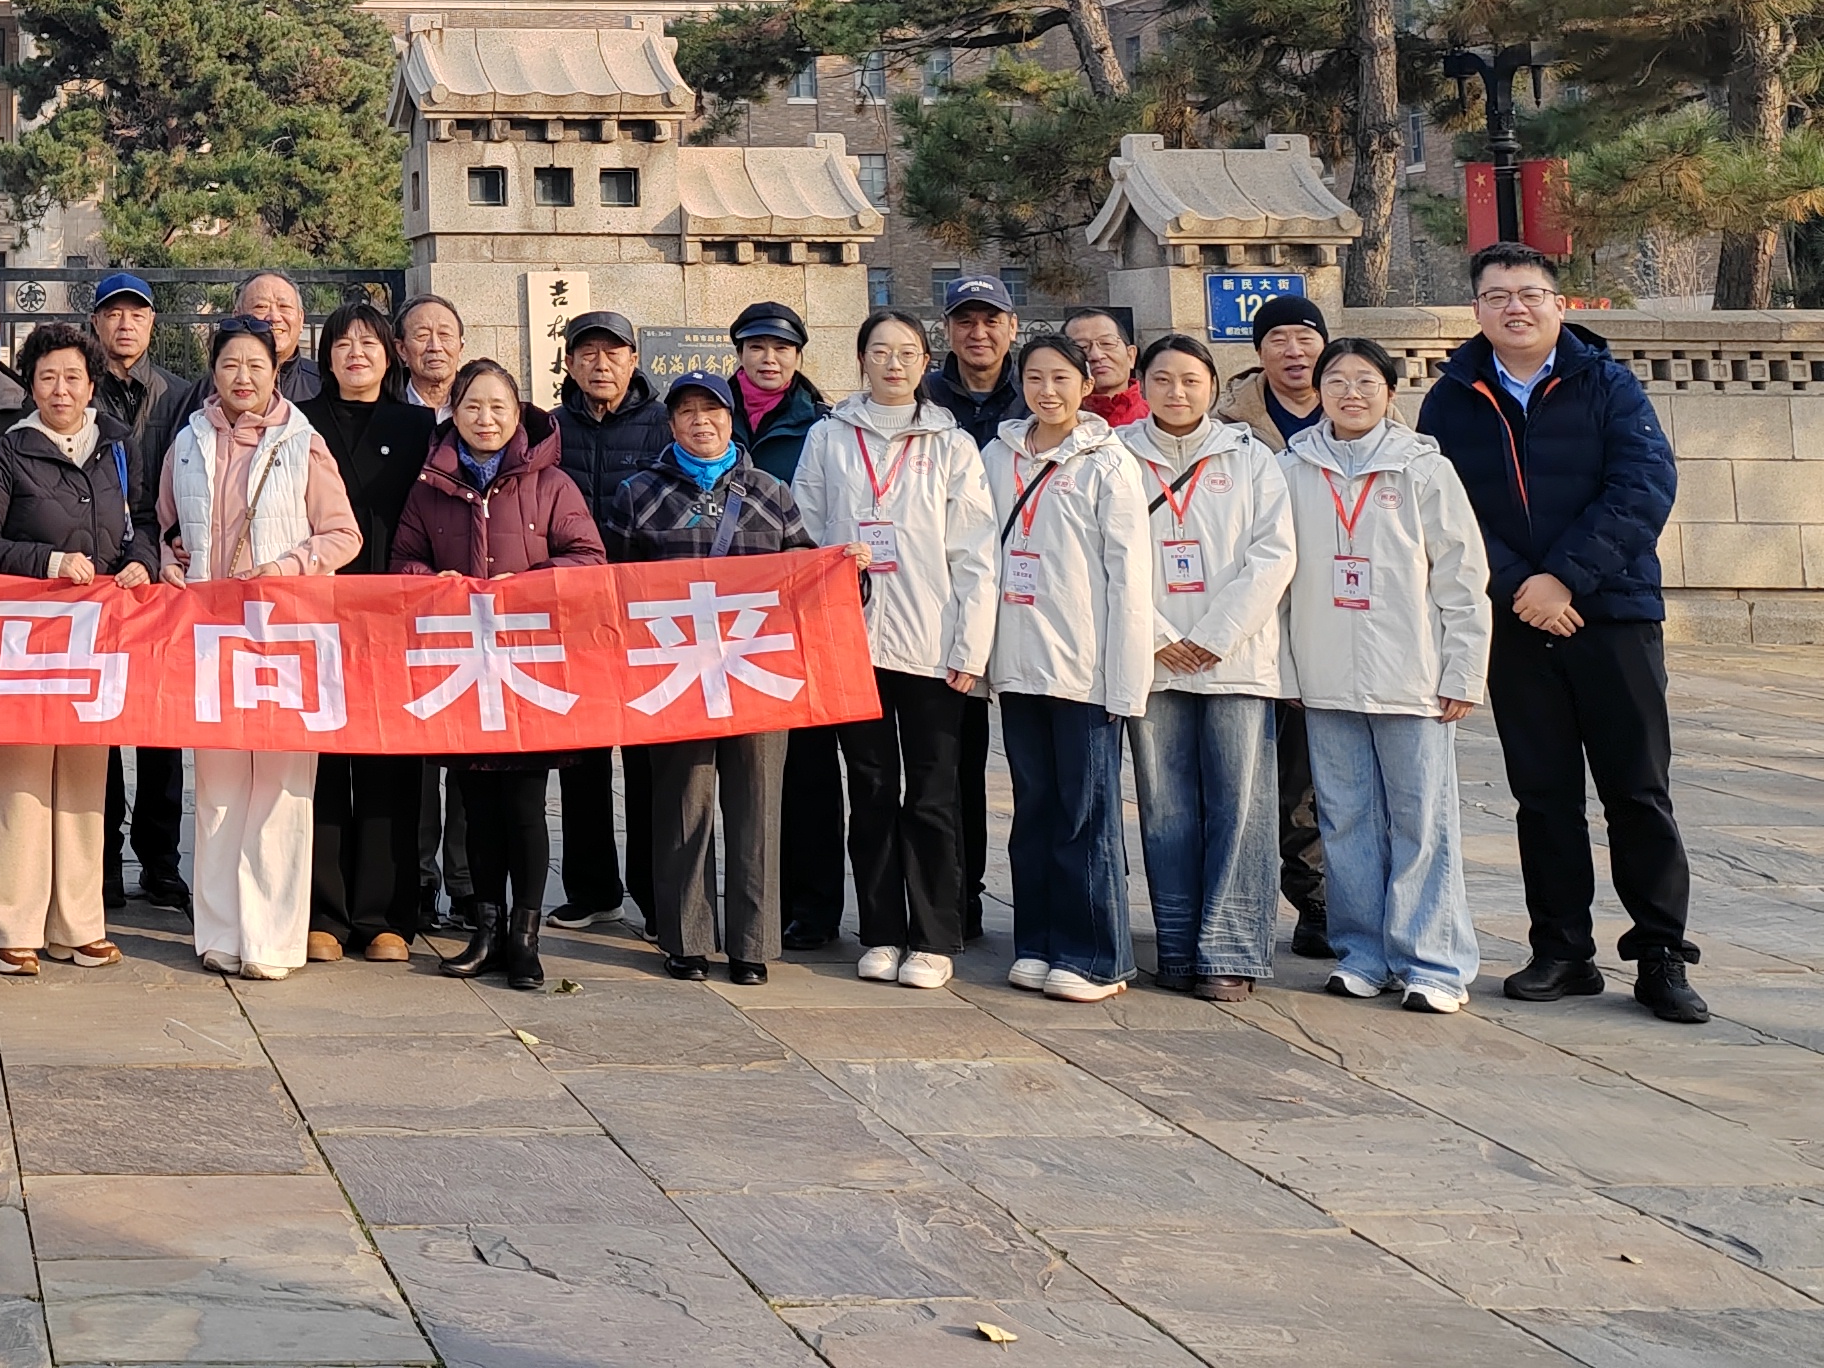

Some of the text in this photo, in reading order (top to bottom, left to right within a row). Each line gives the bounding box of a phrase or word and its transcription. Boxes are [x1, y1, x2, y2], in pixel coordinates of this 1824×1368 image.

[1222, 278, 1290, 291] 新民大街
[1235, 293, 1279, 322] 12
